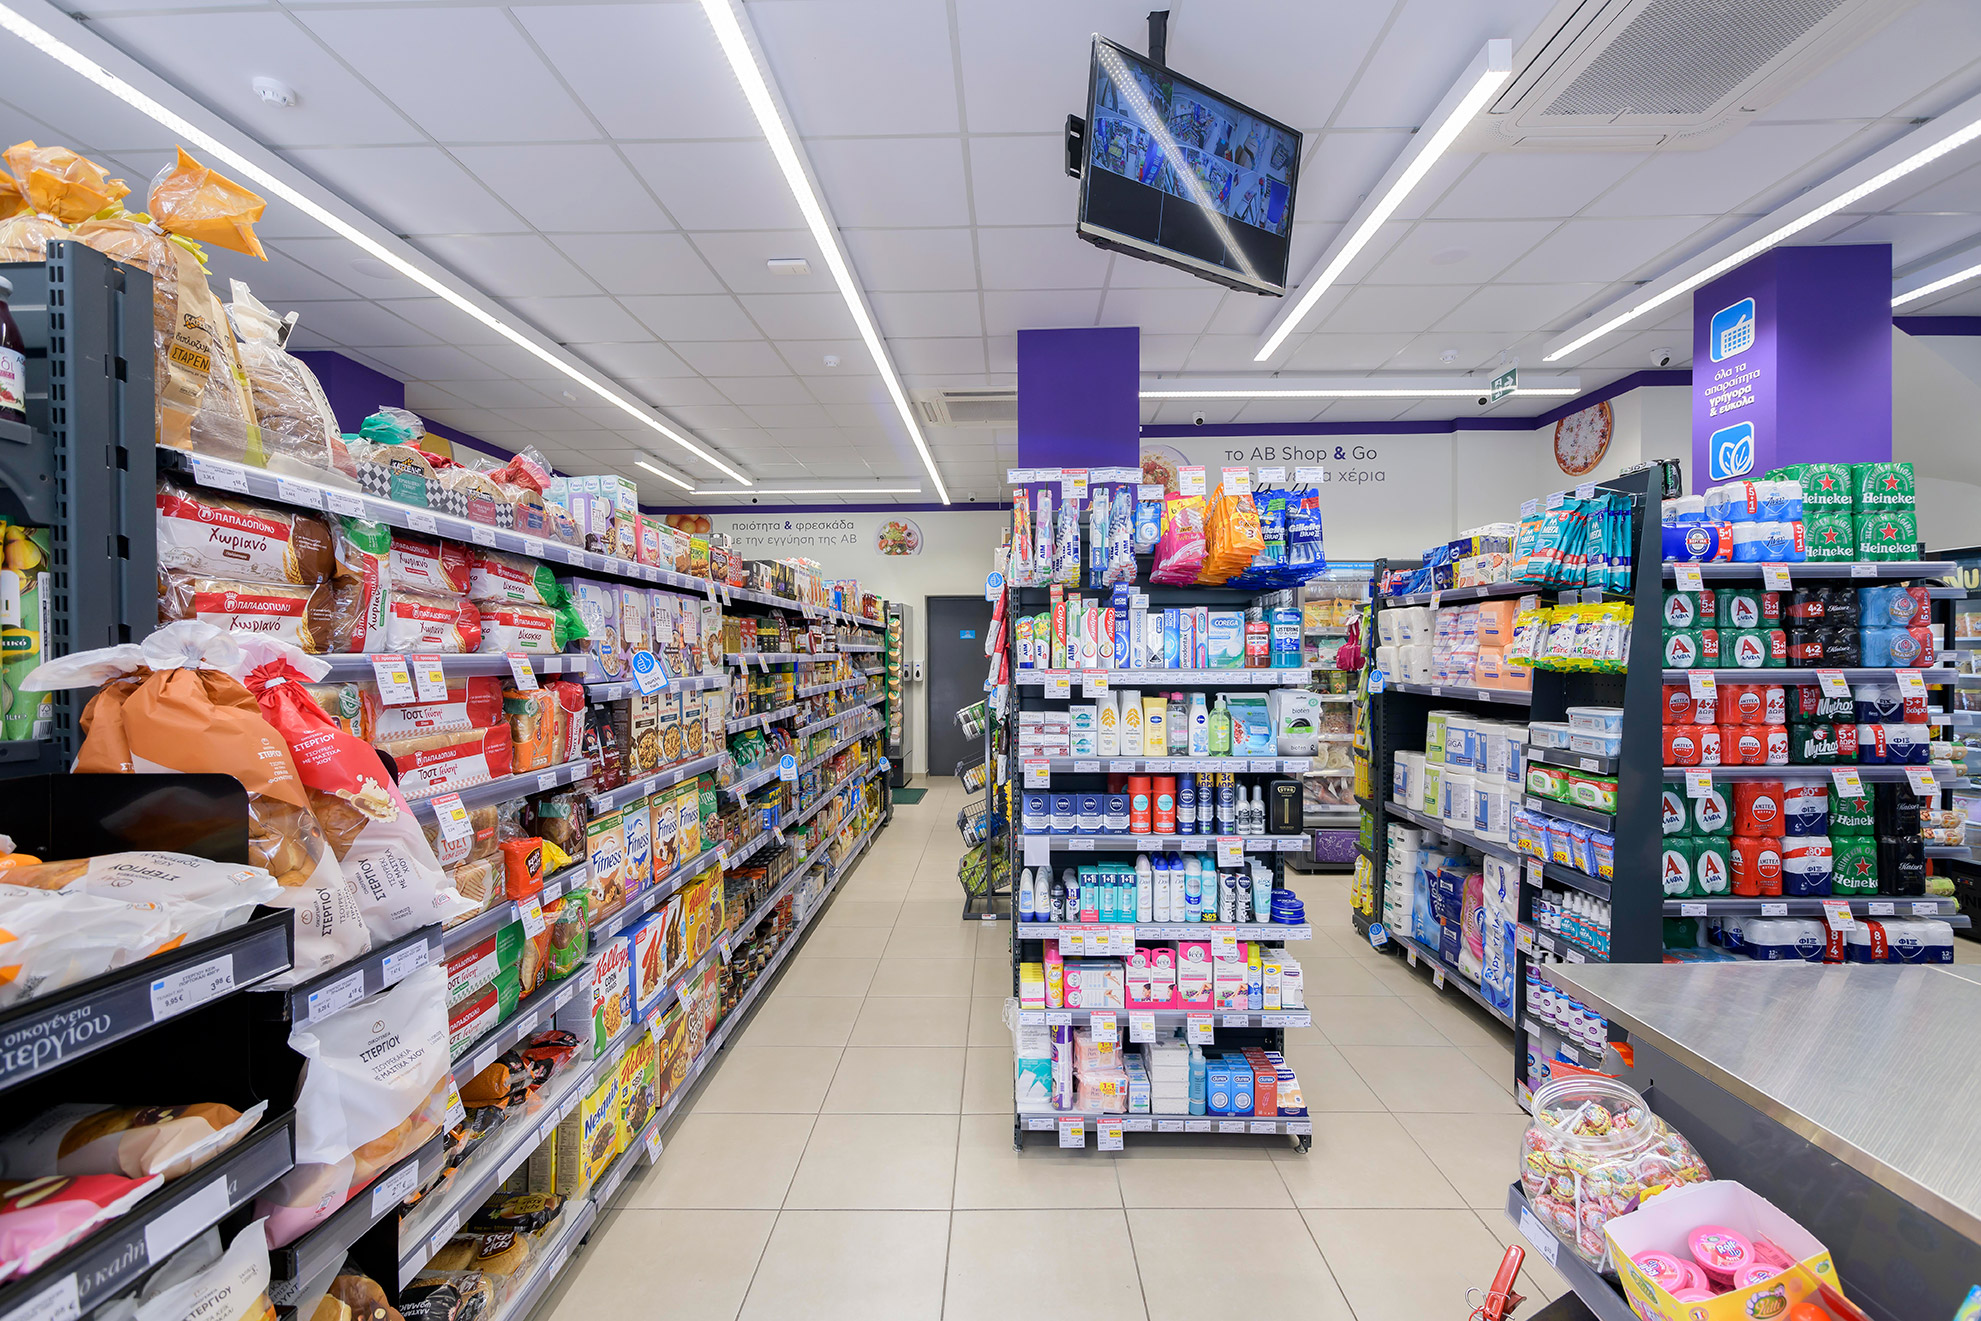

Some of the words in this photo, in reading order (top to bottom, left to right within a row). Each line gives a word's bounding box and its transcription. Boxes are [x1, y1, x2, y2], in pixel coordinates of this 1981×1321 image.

[1704, 369, 1761, 396] απαραίτητα
[1714, 368, 1733, 381] όλα
[1734, 362, 1747, 373] τα
[1709, 384, 1752, 408] γρήγορα
[1709, 407, 1718, 417] &
[1719, 395, 1755, 414] εύκολα
[1225, 450, 1244, 461] το
[1282, 446, 1327, 463] Shop
[1333, 446, 1346, 460] &
[1352, 446, 1378, 460] Go
[1338, 467, 1386, 485] χέρια
[732, 520, 781, 532] ποιότητα
[784, 520, 792, 530] &
[795, 519, 854, 532] φρεσκάδα
[1289, 523, 1321, 534] Gillette
[209, 527, 267, 552] Χωριανό
[745, 536, 765, 547] την
[767, 534, 815, 546] εγγύηση
[819, 535, 837, 546] της
[1860, 542, 1918, 554] Heineken
[230, 615, 281, 632] Χωριανό
[1056, 604, 1065, 640] Colgate
[1089, 608, 1098, 638] Colgate
[1106, 609, 1115, 638] Colgate
[1214, 619, 1239, 628] COREGA
[1817, 698, 1854, 719] Mythos
[293, 733, 335, 752] ΣΤΕΡΓΙΟΥ
[1838, 729, 1857, 740] 5+1
[1804, 738, 1839, 759] Mythos
[680, 806, 698, 827] Fitness
[657, 817, 678, 840] Fitness
[627, 831, 649, 856] Fitness
[592, 849, 622, 873] Fitness
[359, 859, 387, 901] ΣΤΕΡΓΙΟΥ
[315, 887, 333, 937] ΣΤΕΡΓΙΟΥ
[4, 1005, 92, 1048] οικογένεια
[359, 1034, 400, 1064] ΣΤΕΡΓΙΟΥ
[584, 1077, 619, 1141] Nesquik
